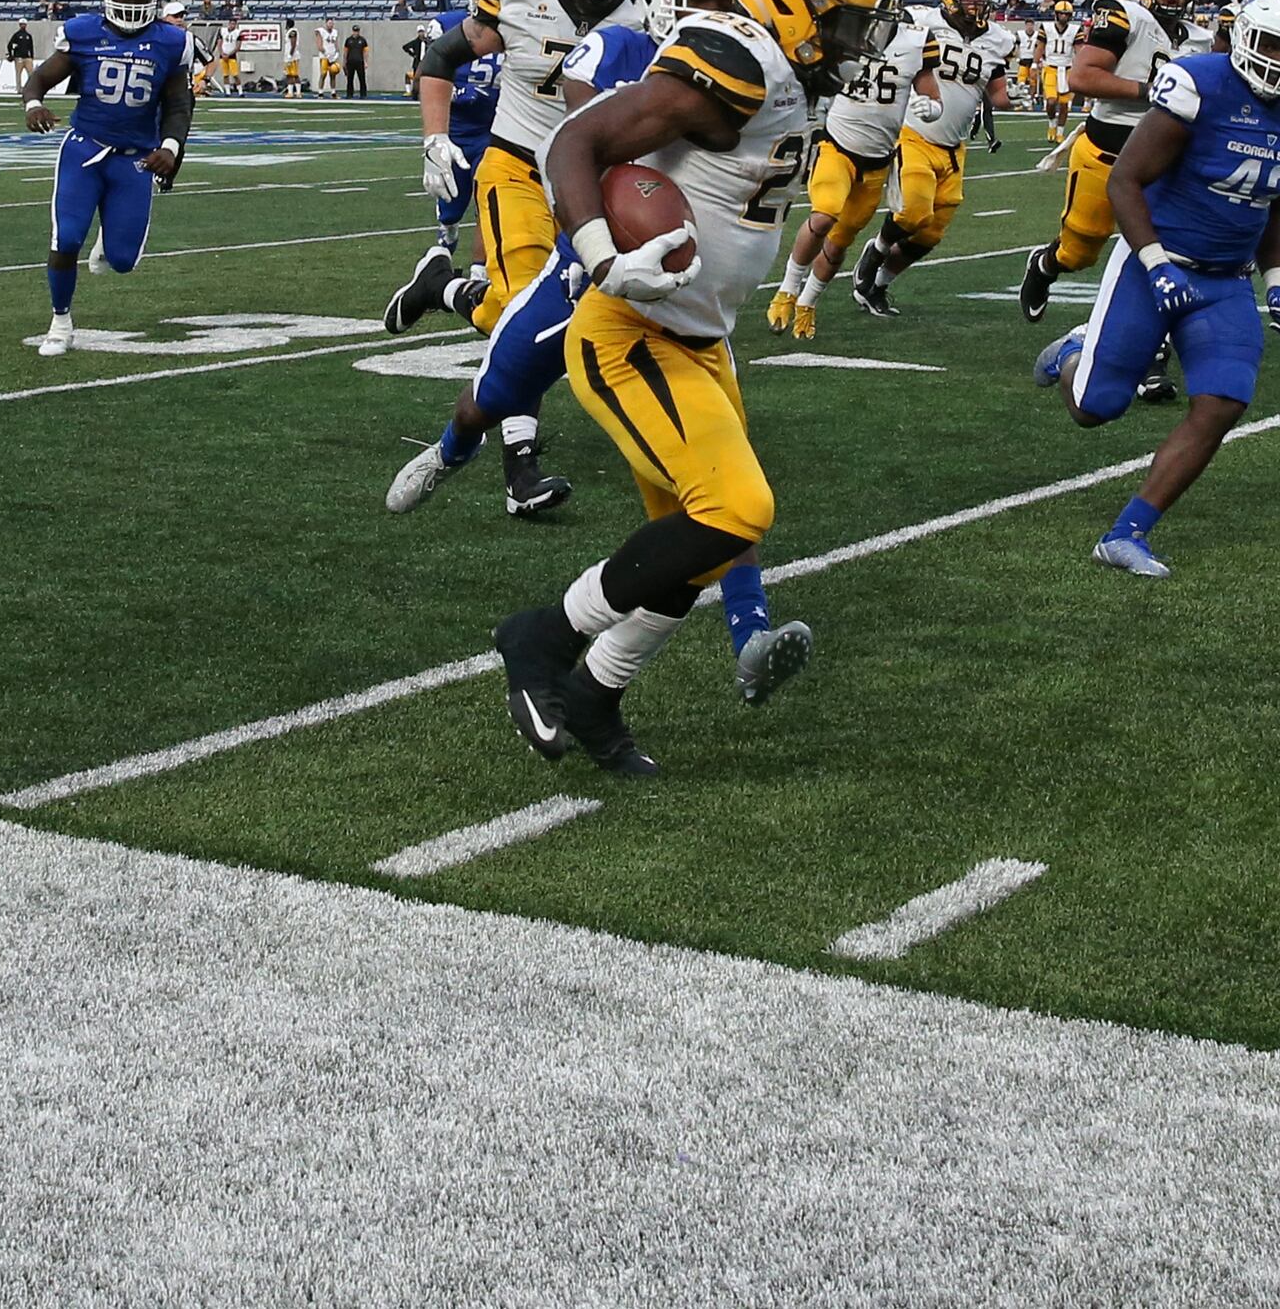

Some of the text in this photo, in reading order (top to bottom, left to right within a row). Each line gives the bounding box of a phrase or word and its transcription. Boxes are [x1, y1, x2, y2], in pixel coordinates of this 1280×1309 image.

[1053, 39, 1067, 54] 11
[938, 44, 982, 85] 58
[95, 60, 155, 107] 95
[1227, 140, 1275, 160] GEORGIA
